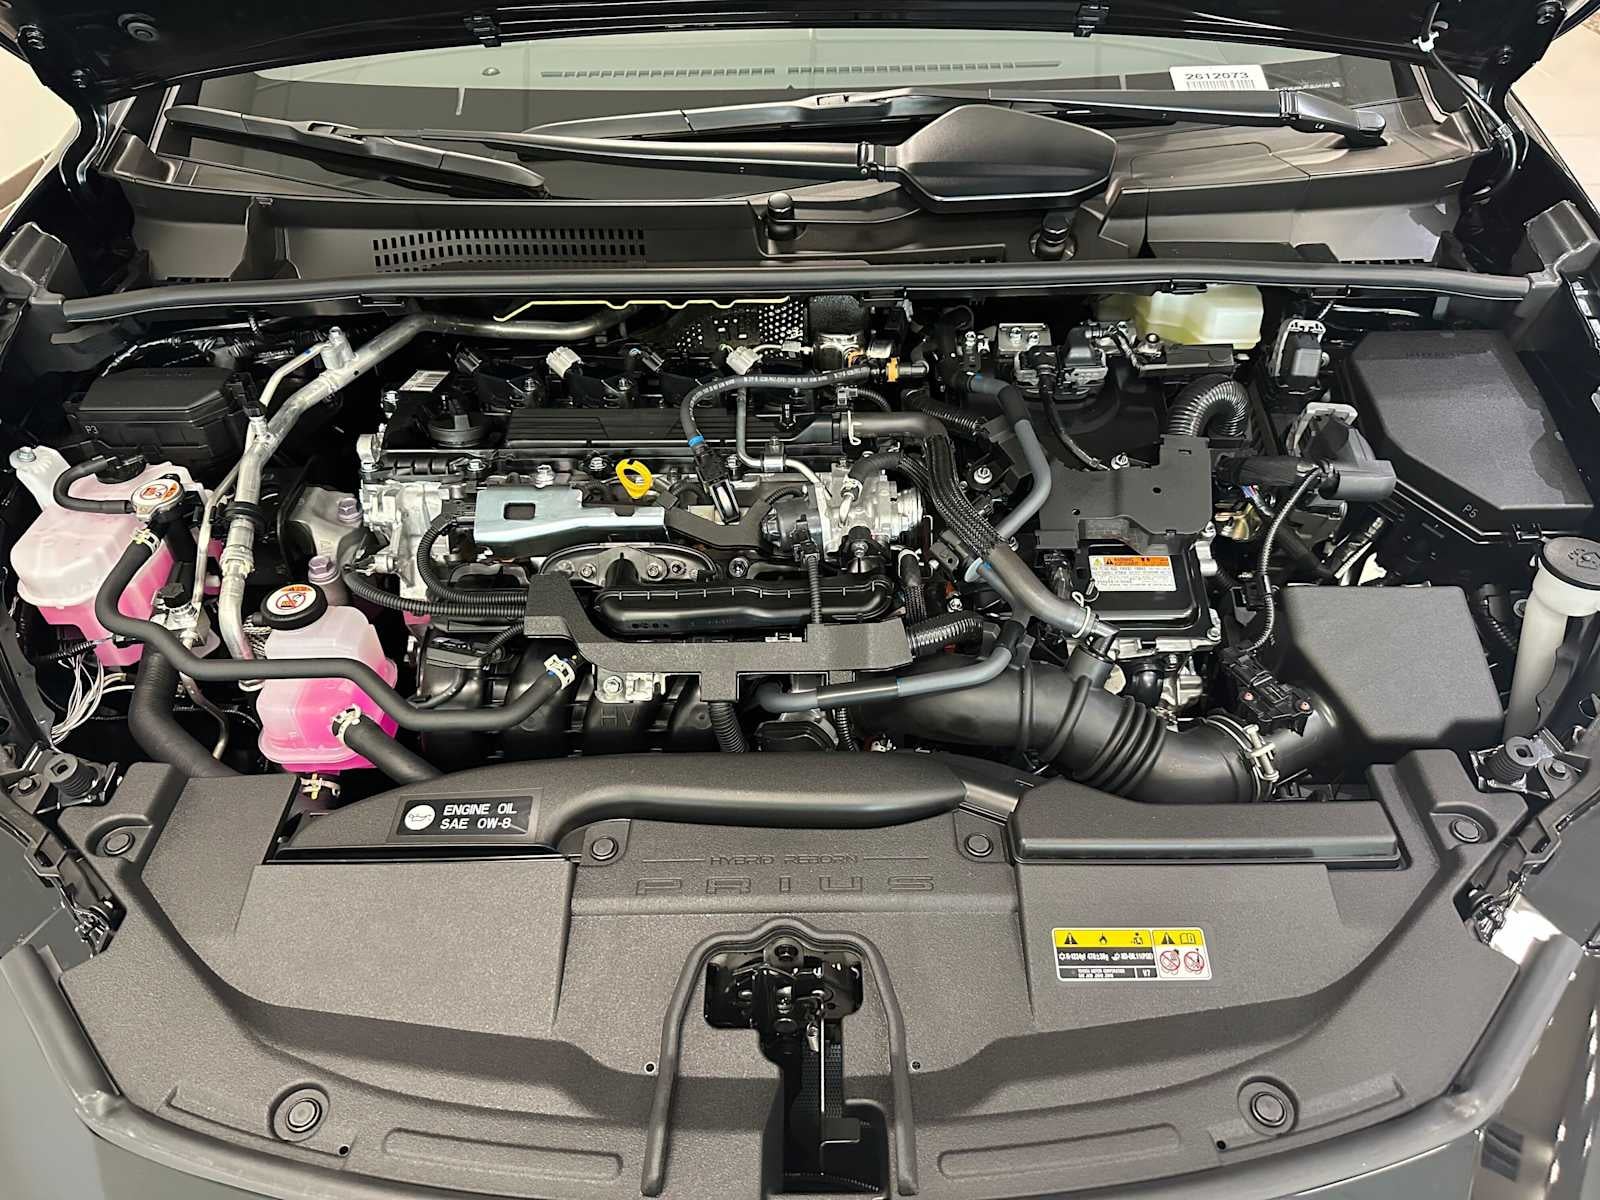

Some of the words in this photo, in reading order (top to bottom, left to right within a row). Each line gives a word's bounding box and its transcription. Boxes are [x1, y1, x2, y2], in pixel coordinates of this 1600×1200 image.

[1184, 72, 1249, 80] 2612073
[443, 803, 491, 816] ENGINE
[497, 802, 518, 815] OIL
[440, 817, 470, 830] SAE
[477, 817, 512, 830] 0W-8
[709, 855, 775, 866] HYBRID
[783, 854, 858, 865] REBORN
[635, 875, 935, 896] PRIUS
